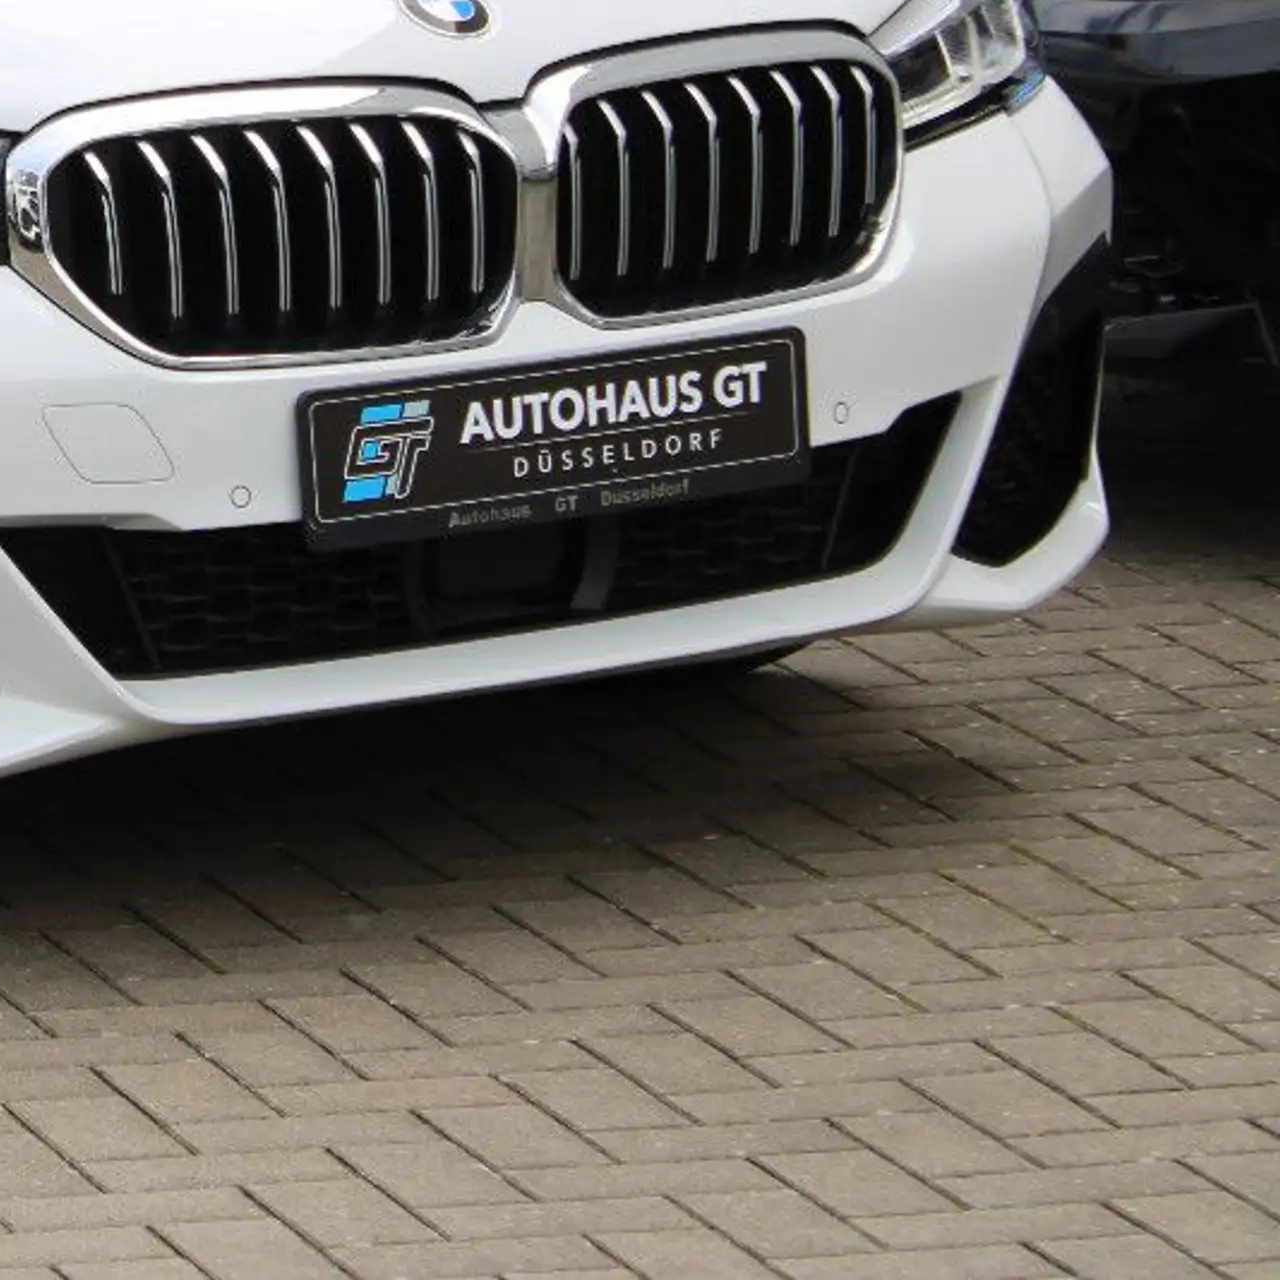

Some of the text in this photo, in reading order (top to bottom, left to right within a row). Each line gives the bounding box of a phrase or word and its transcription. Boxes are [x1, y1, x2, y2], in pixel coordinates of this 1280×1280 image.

[459, 362, 767, 444] AUTOHAUS GT
[514, 428, 722, 477] DÜSSELDORF
[448, 504, 532, 528] Autohaus
[554, 495, 580, 513] GT
